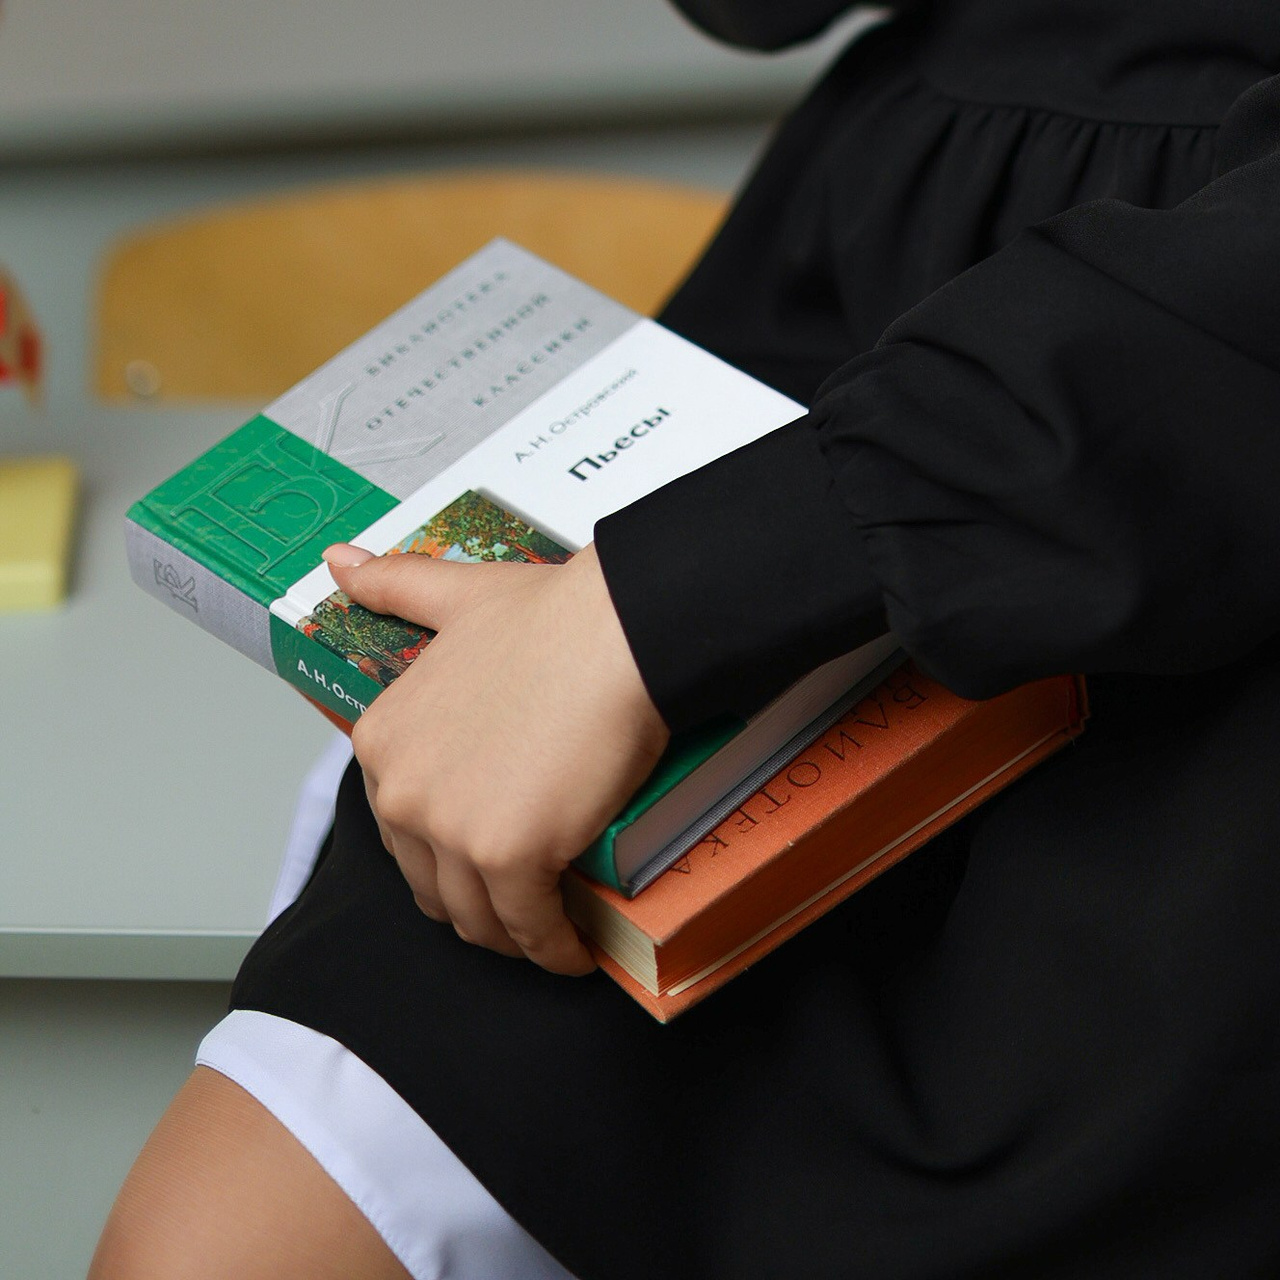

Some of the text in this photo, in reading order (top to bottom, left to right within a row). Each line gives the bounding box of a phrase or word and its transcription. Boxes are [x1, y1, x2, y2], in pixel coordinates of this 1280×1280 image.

[364, 271, 508, 377] БИБЛИОТЕКА
[366, 293, 550, 430] ОТЕЧЕСТВЕННОЙ
[472, 316, 592, 407] КЛАССИКИ
[568, 407, 672, 481] Пьесы
[667, 679, 929, 876] БЛИОТЕКА
